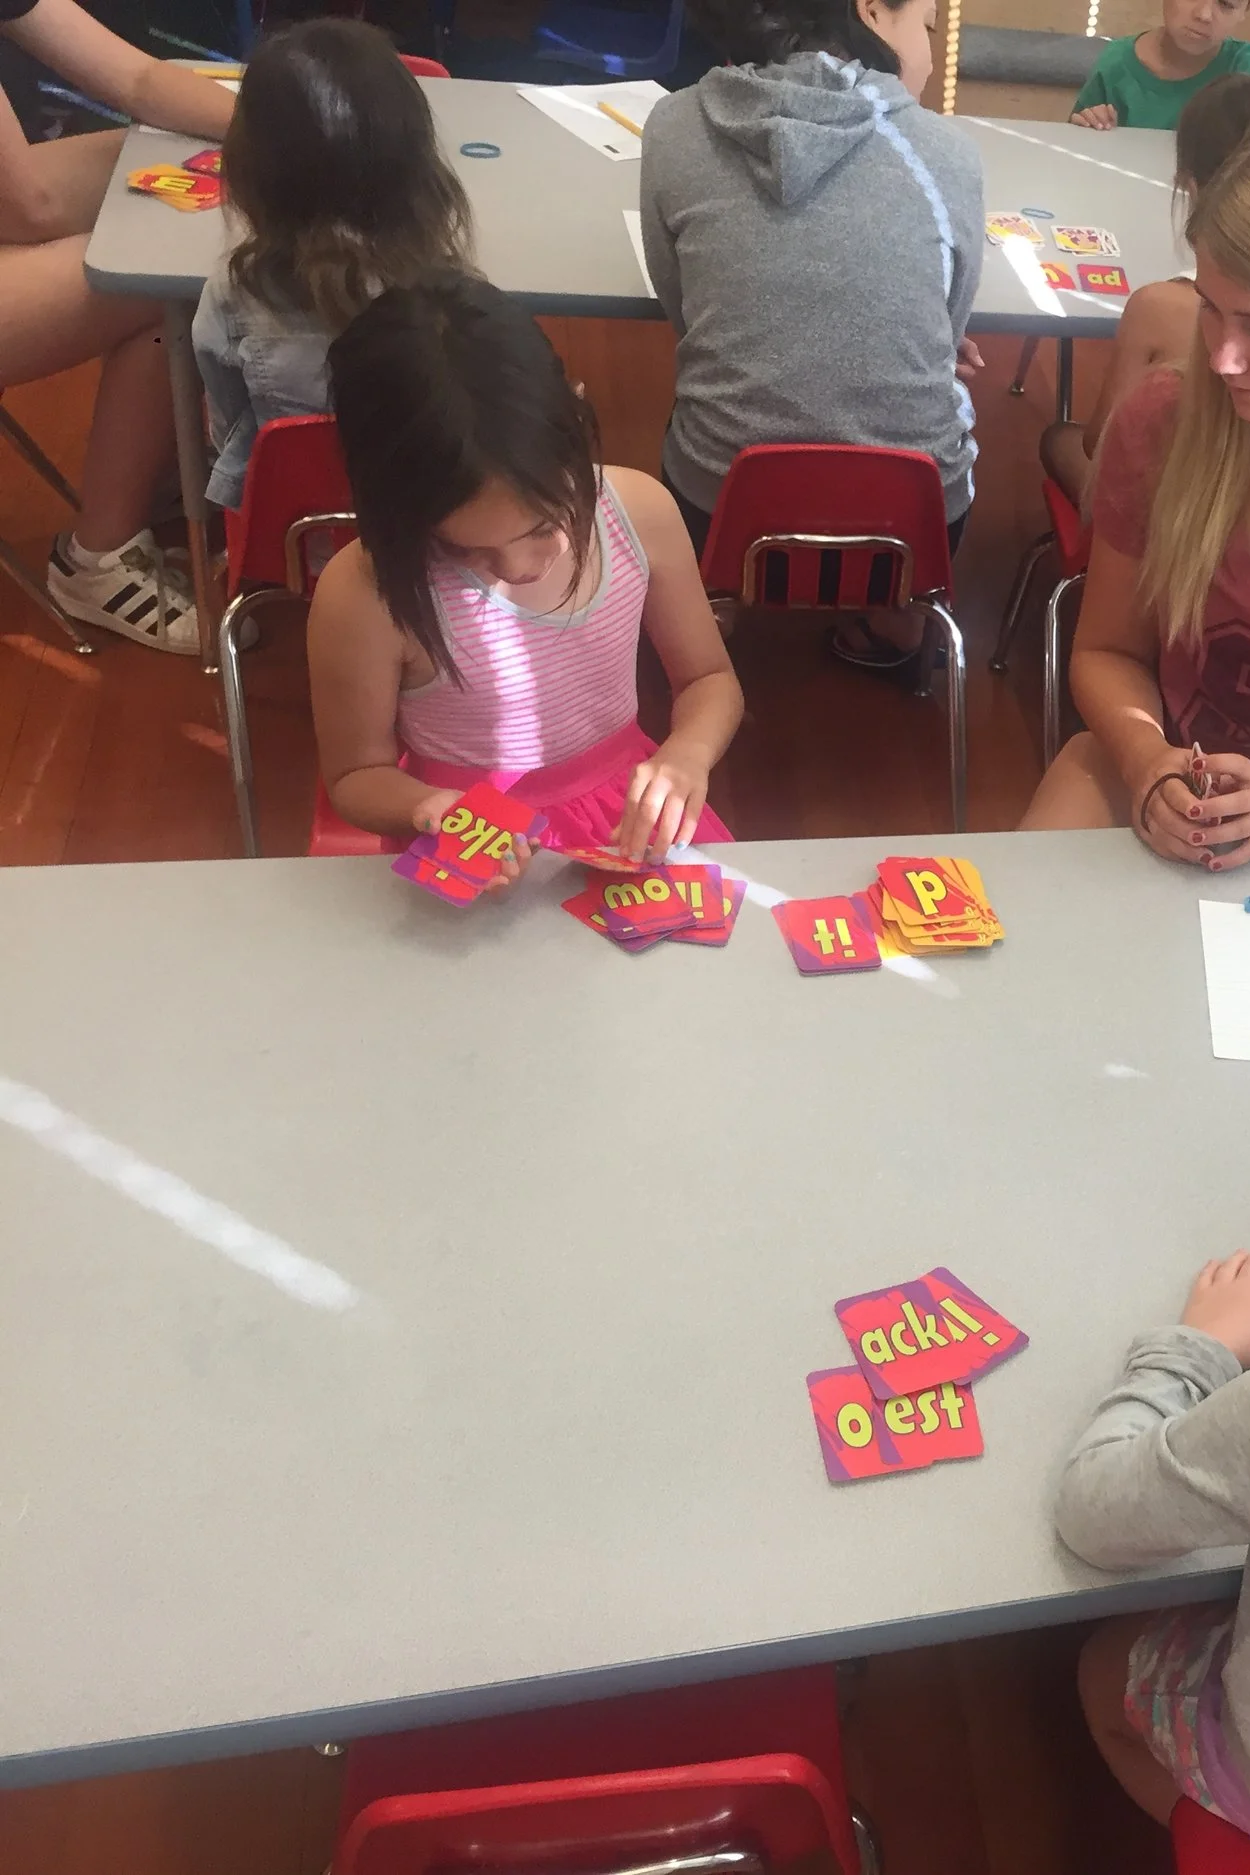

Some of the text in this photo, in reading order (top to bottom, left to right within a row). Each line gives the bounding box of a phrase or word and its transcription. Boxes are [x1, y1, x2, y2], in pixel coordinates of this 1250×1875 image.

[1087, 270, 1122, 287] ad
[441, 807, 514, 862] ake
[836, 1402, 874, 1448] o
[884, 1382, 966, 1435] est
